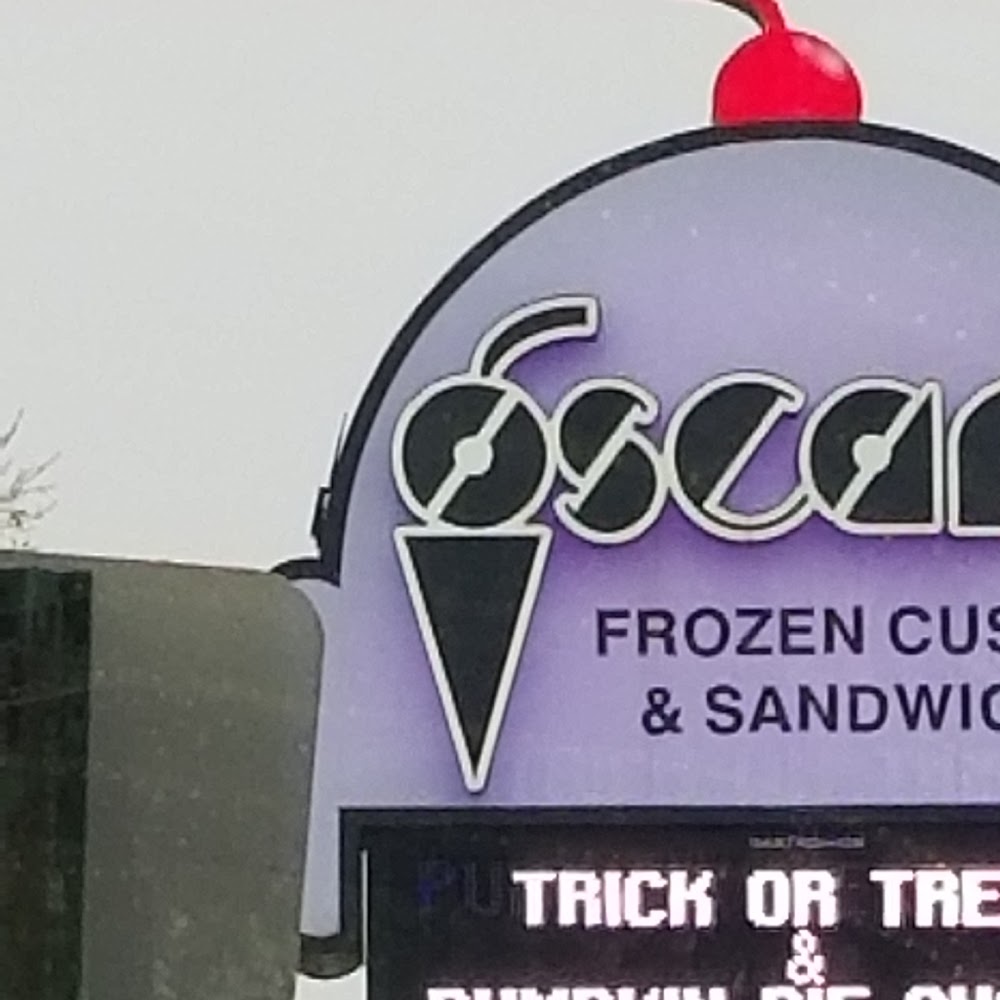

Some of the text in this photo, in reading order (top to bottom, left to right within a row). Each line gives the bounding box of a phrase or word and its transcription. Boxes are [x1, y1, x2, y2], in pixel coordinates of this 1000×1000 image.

[597, 605, 864, 657] FROZEN
[641, 686, 683, 736] &
[512, 869, 714, 928] TRICK
[746, 869, 839, 928] OR
[786, 929, 826, 985] &
